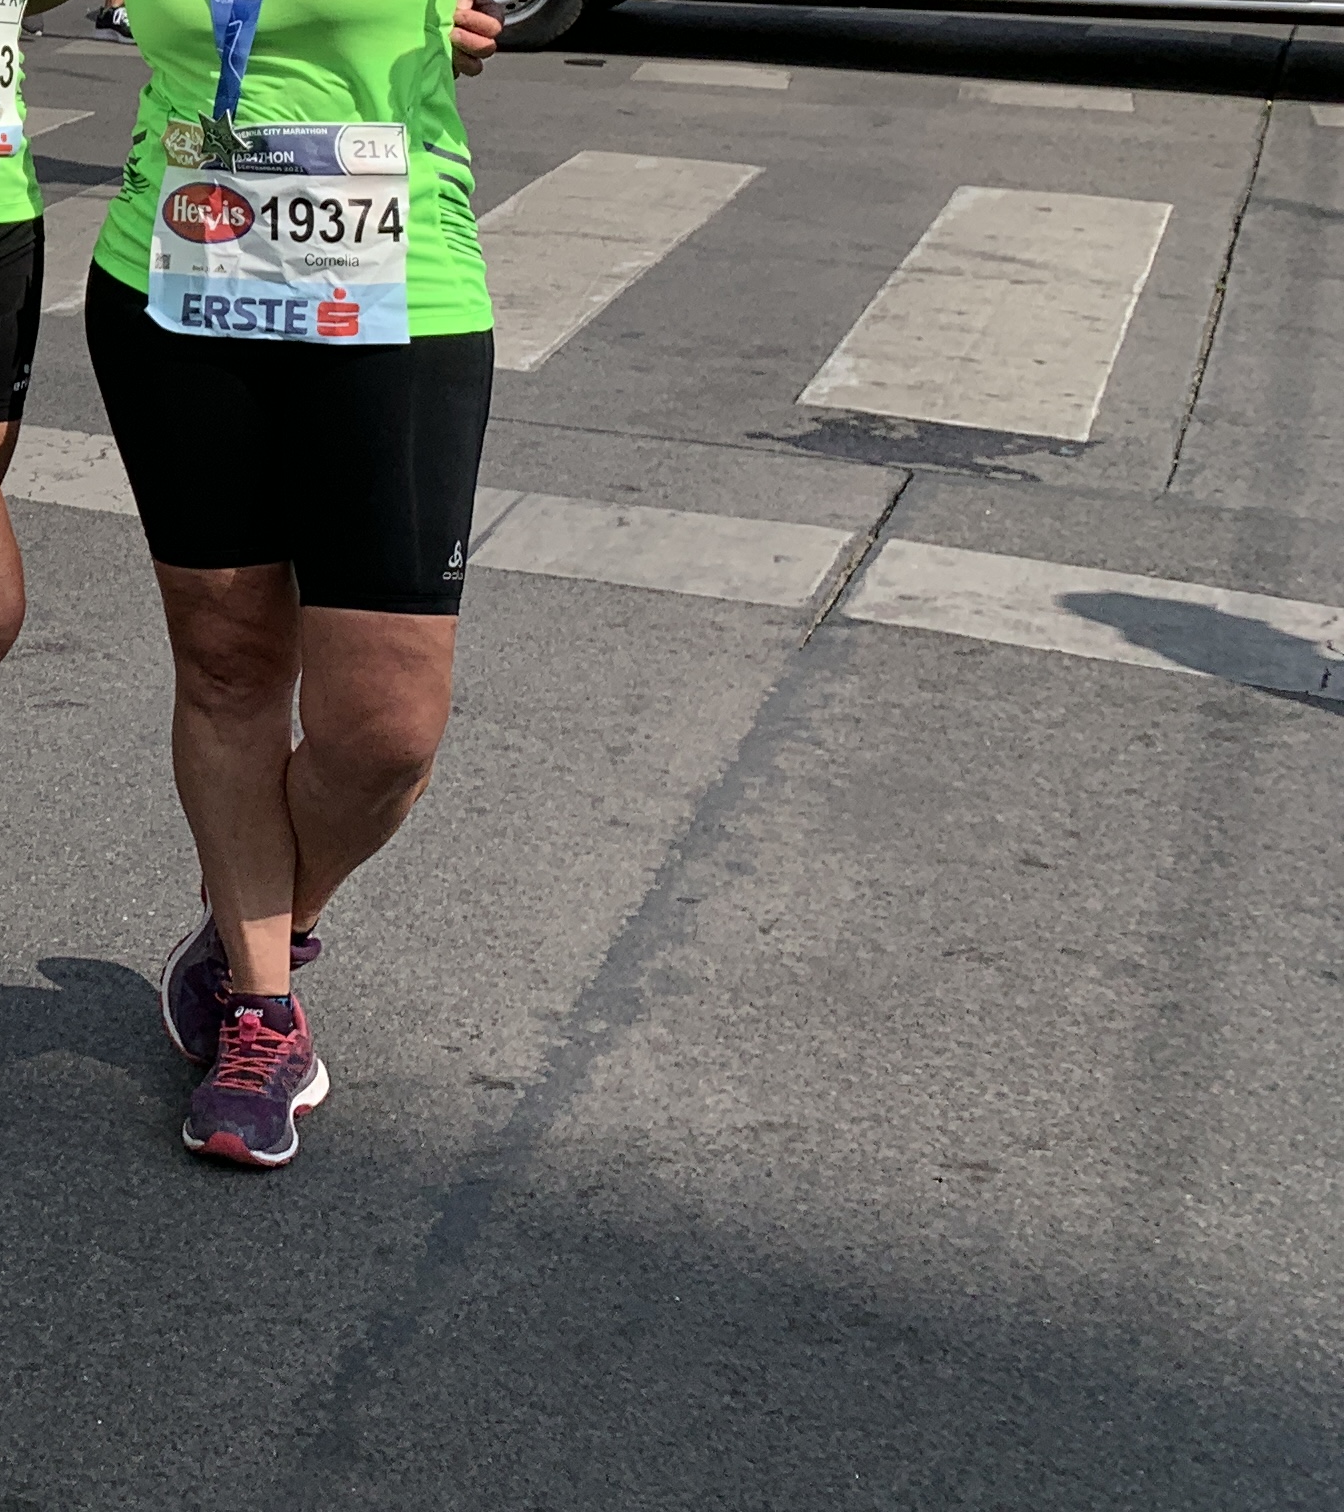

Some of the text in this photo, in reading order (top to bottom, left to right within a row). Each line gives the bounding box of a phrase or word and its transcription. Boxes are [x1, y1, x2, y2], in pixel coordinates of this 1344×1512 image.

[263, 128, 281, 136] CITY
[283, 127, 328, 135] MARATHON
[235, 150, 295, 164] ARATHON
[173, 194, 245, 231] Hervis
[261, 196, 404, 243] 19374
[304, 253, 360, 267] Cornelia
[182, 293, 308, 335] ERSTE
